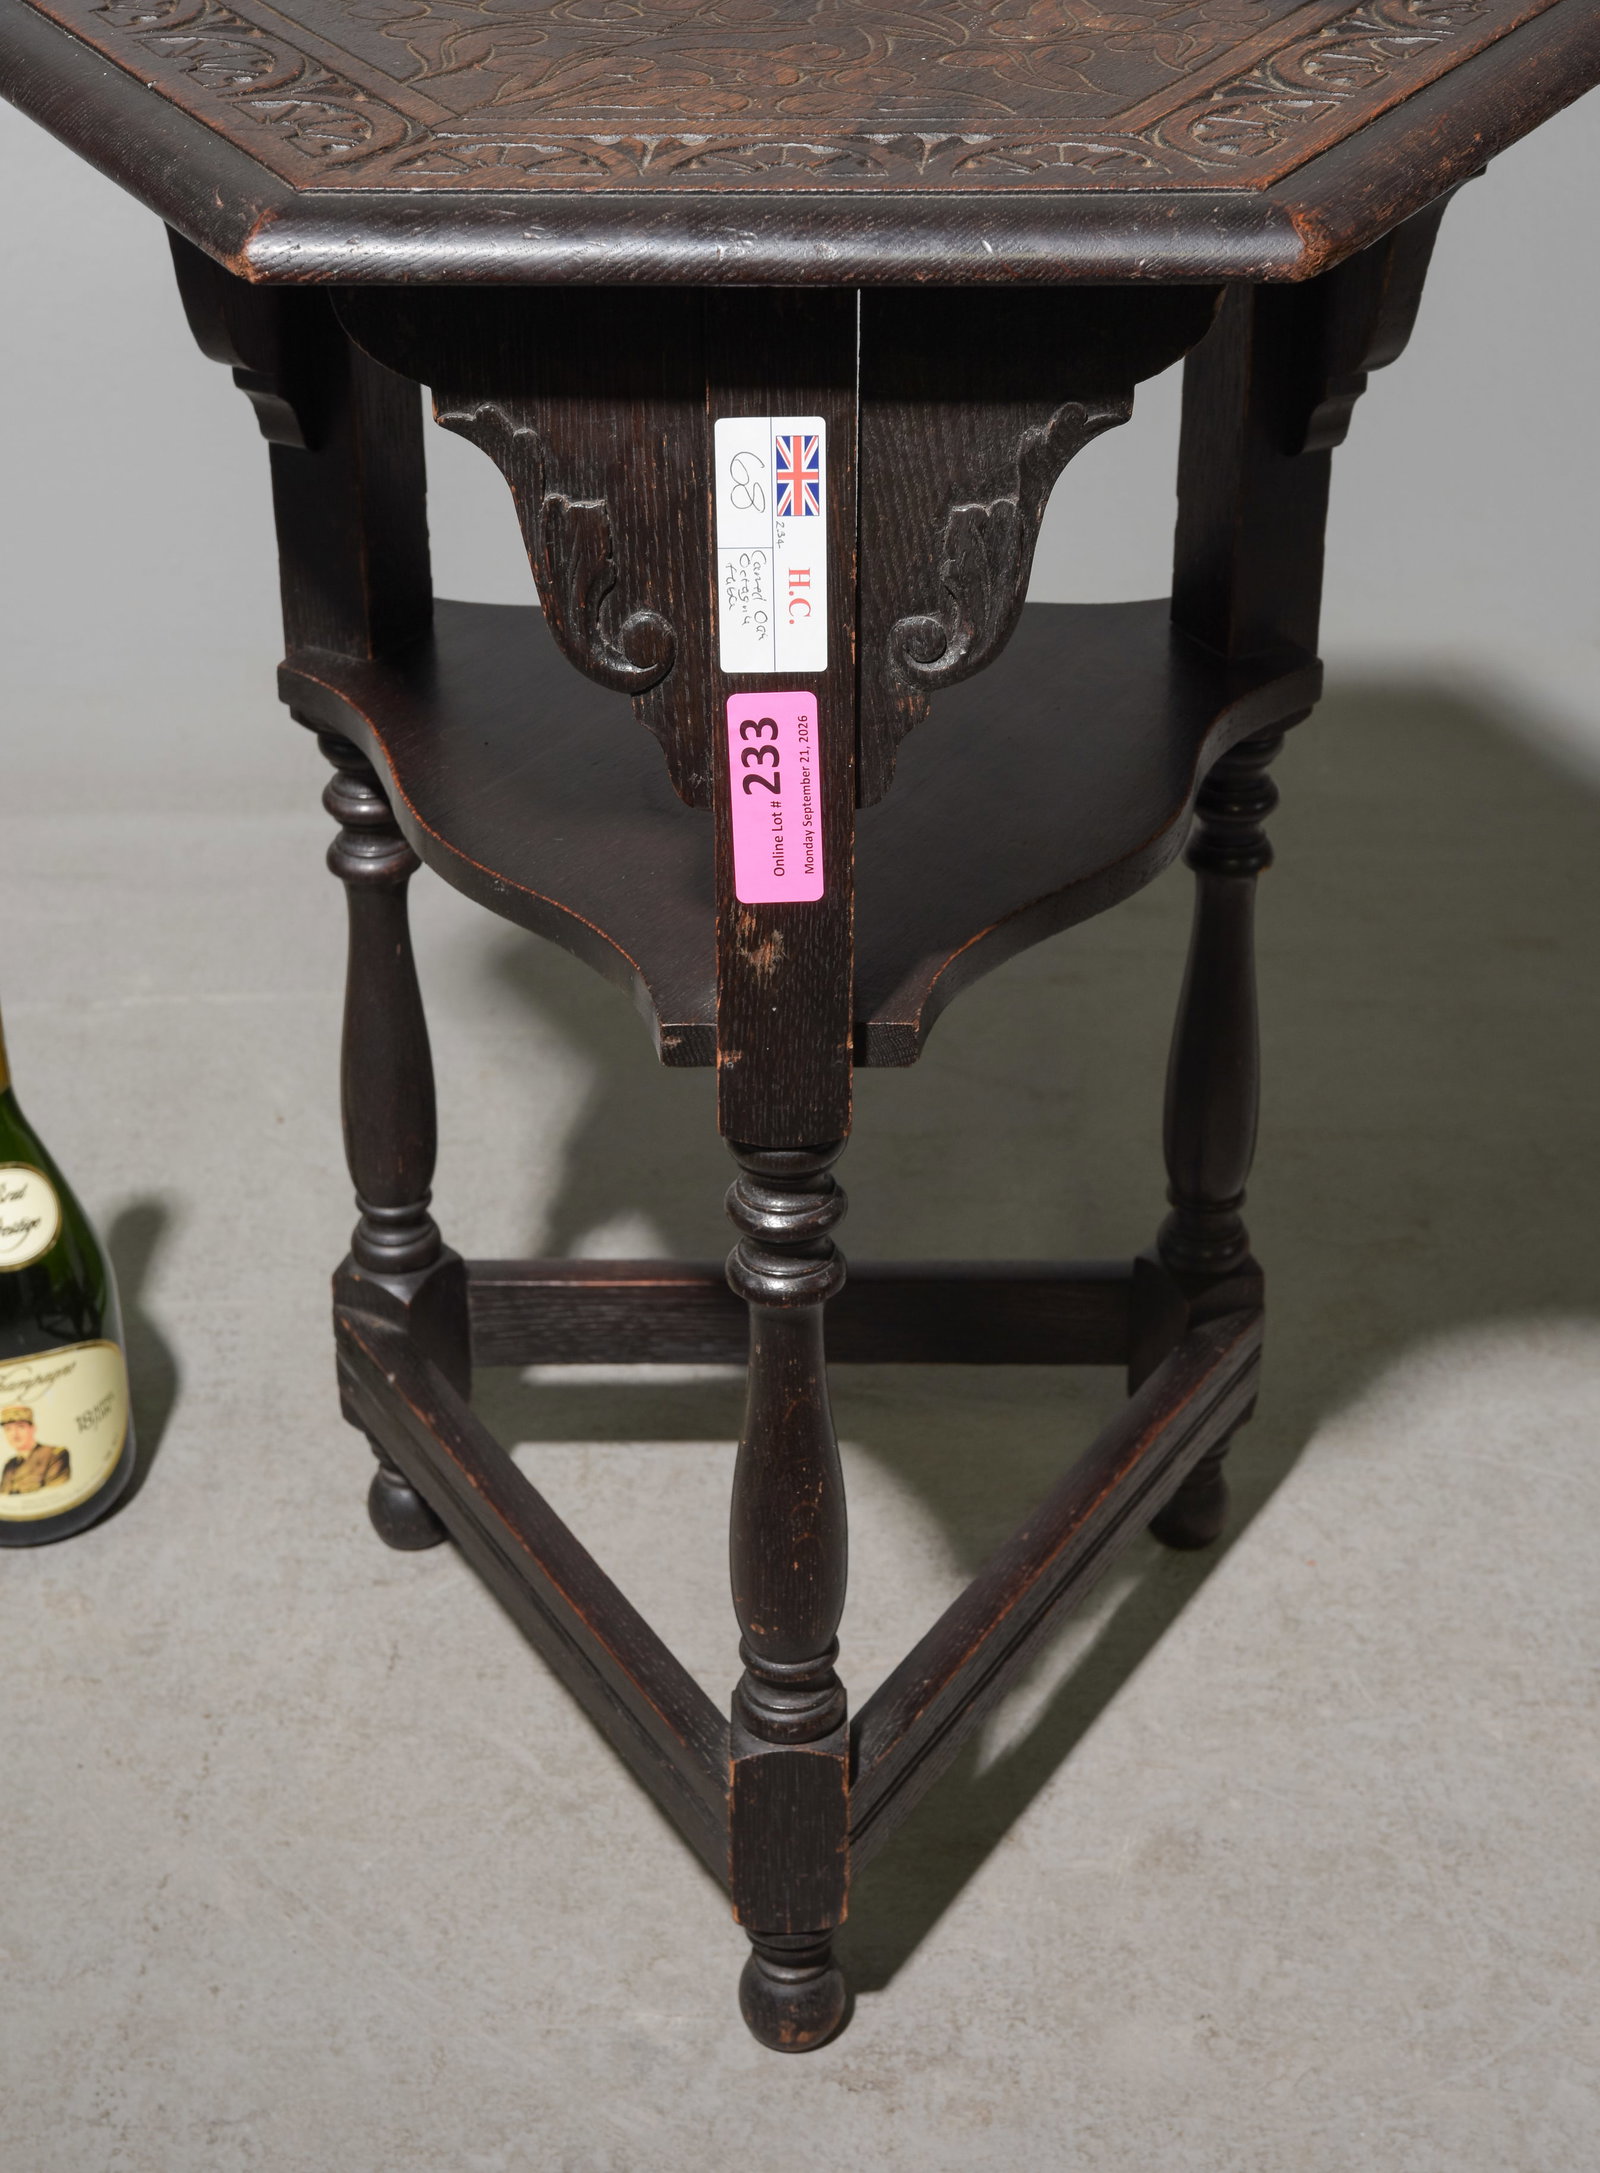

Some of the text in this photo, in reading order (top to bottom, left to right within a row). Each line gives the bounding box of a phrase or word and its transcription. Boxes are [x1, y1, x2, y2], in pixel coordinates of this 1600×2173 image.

[729, 451, 767, 514] 68
[788, 567, 811, 625] H.C.
[739, 716, 786, 877] Online Lot # 233
[797, 714, 815, 875] Monday September 21, 2026
